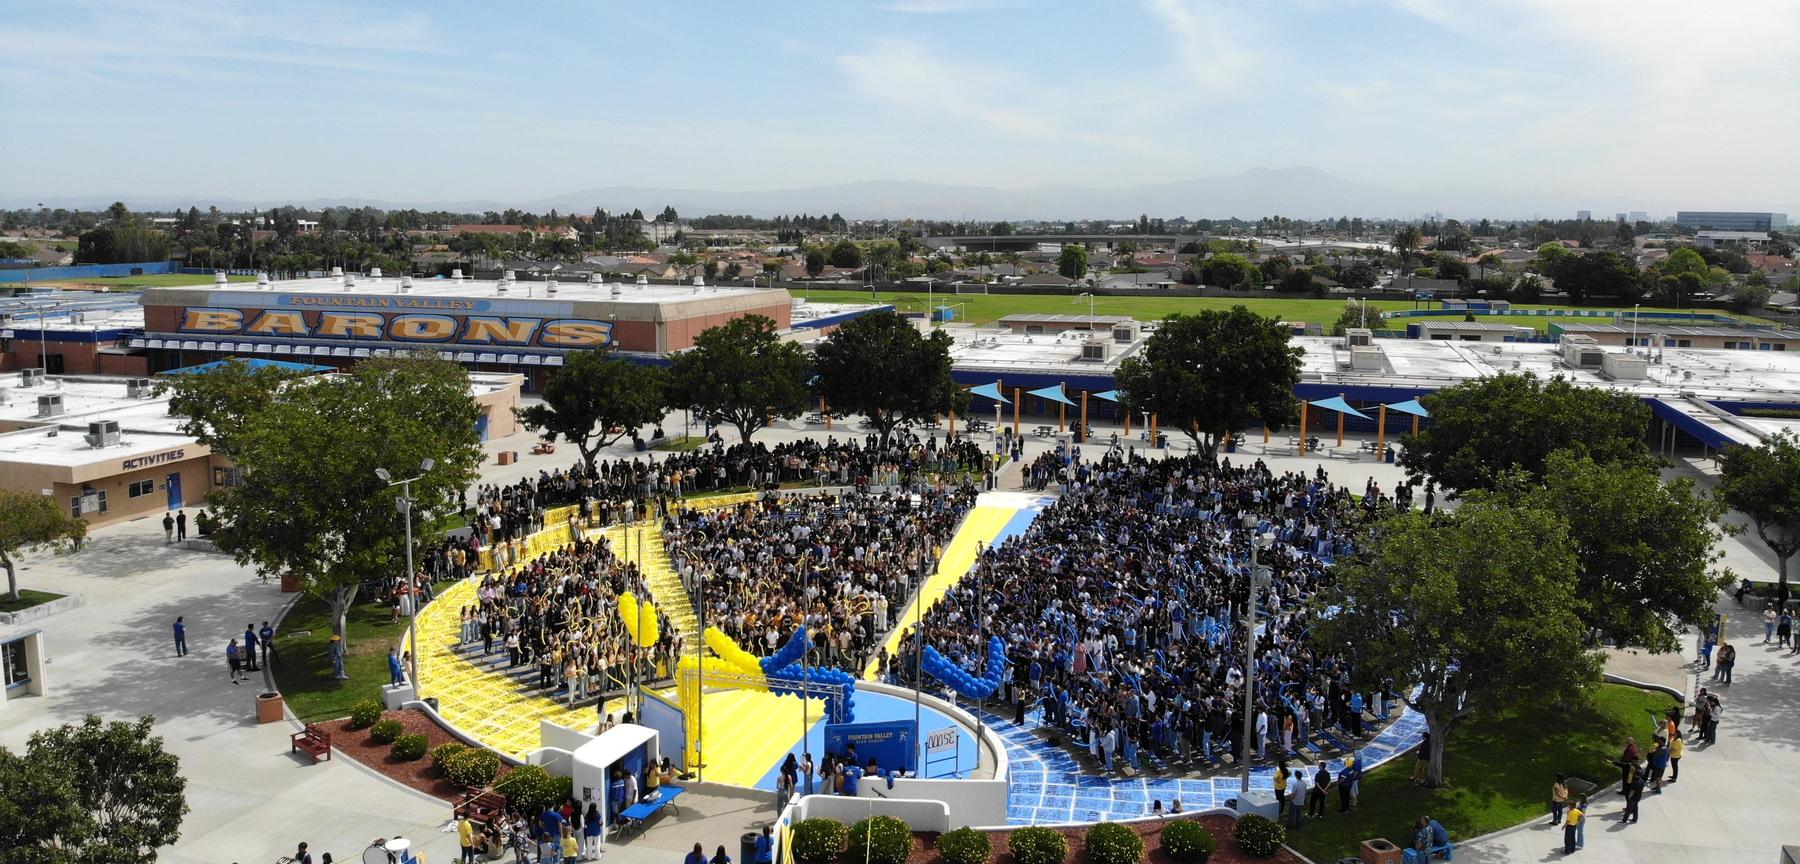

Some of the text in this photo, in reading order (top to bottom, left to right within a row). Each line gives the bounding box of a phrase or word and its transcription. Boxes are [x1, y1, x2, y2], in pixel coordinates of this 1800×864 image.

[290, 296, 475, 310] FOUNTAIN VALLEY
[177, 307, 614, 348] BARONS
[123, 449, 184, 471] ACTIVITIES
